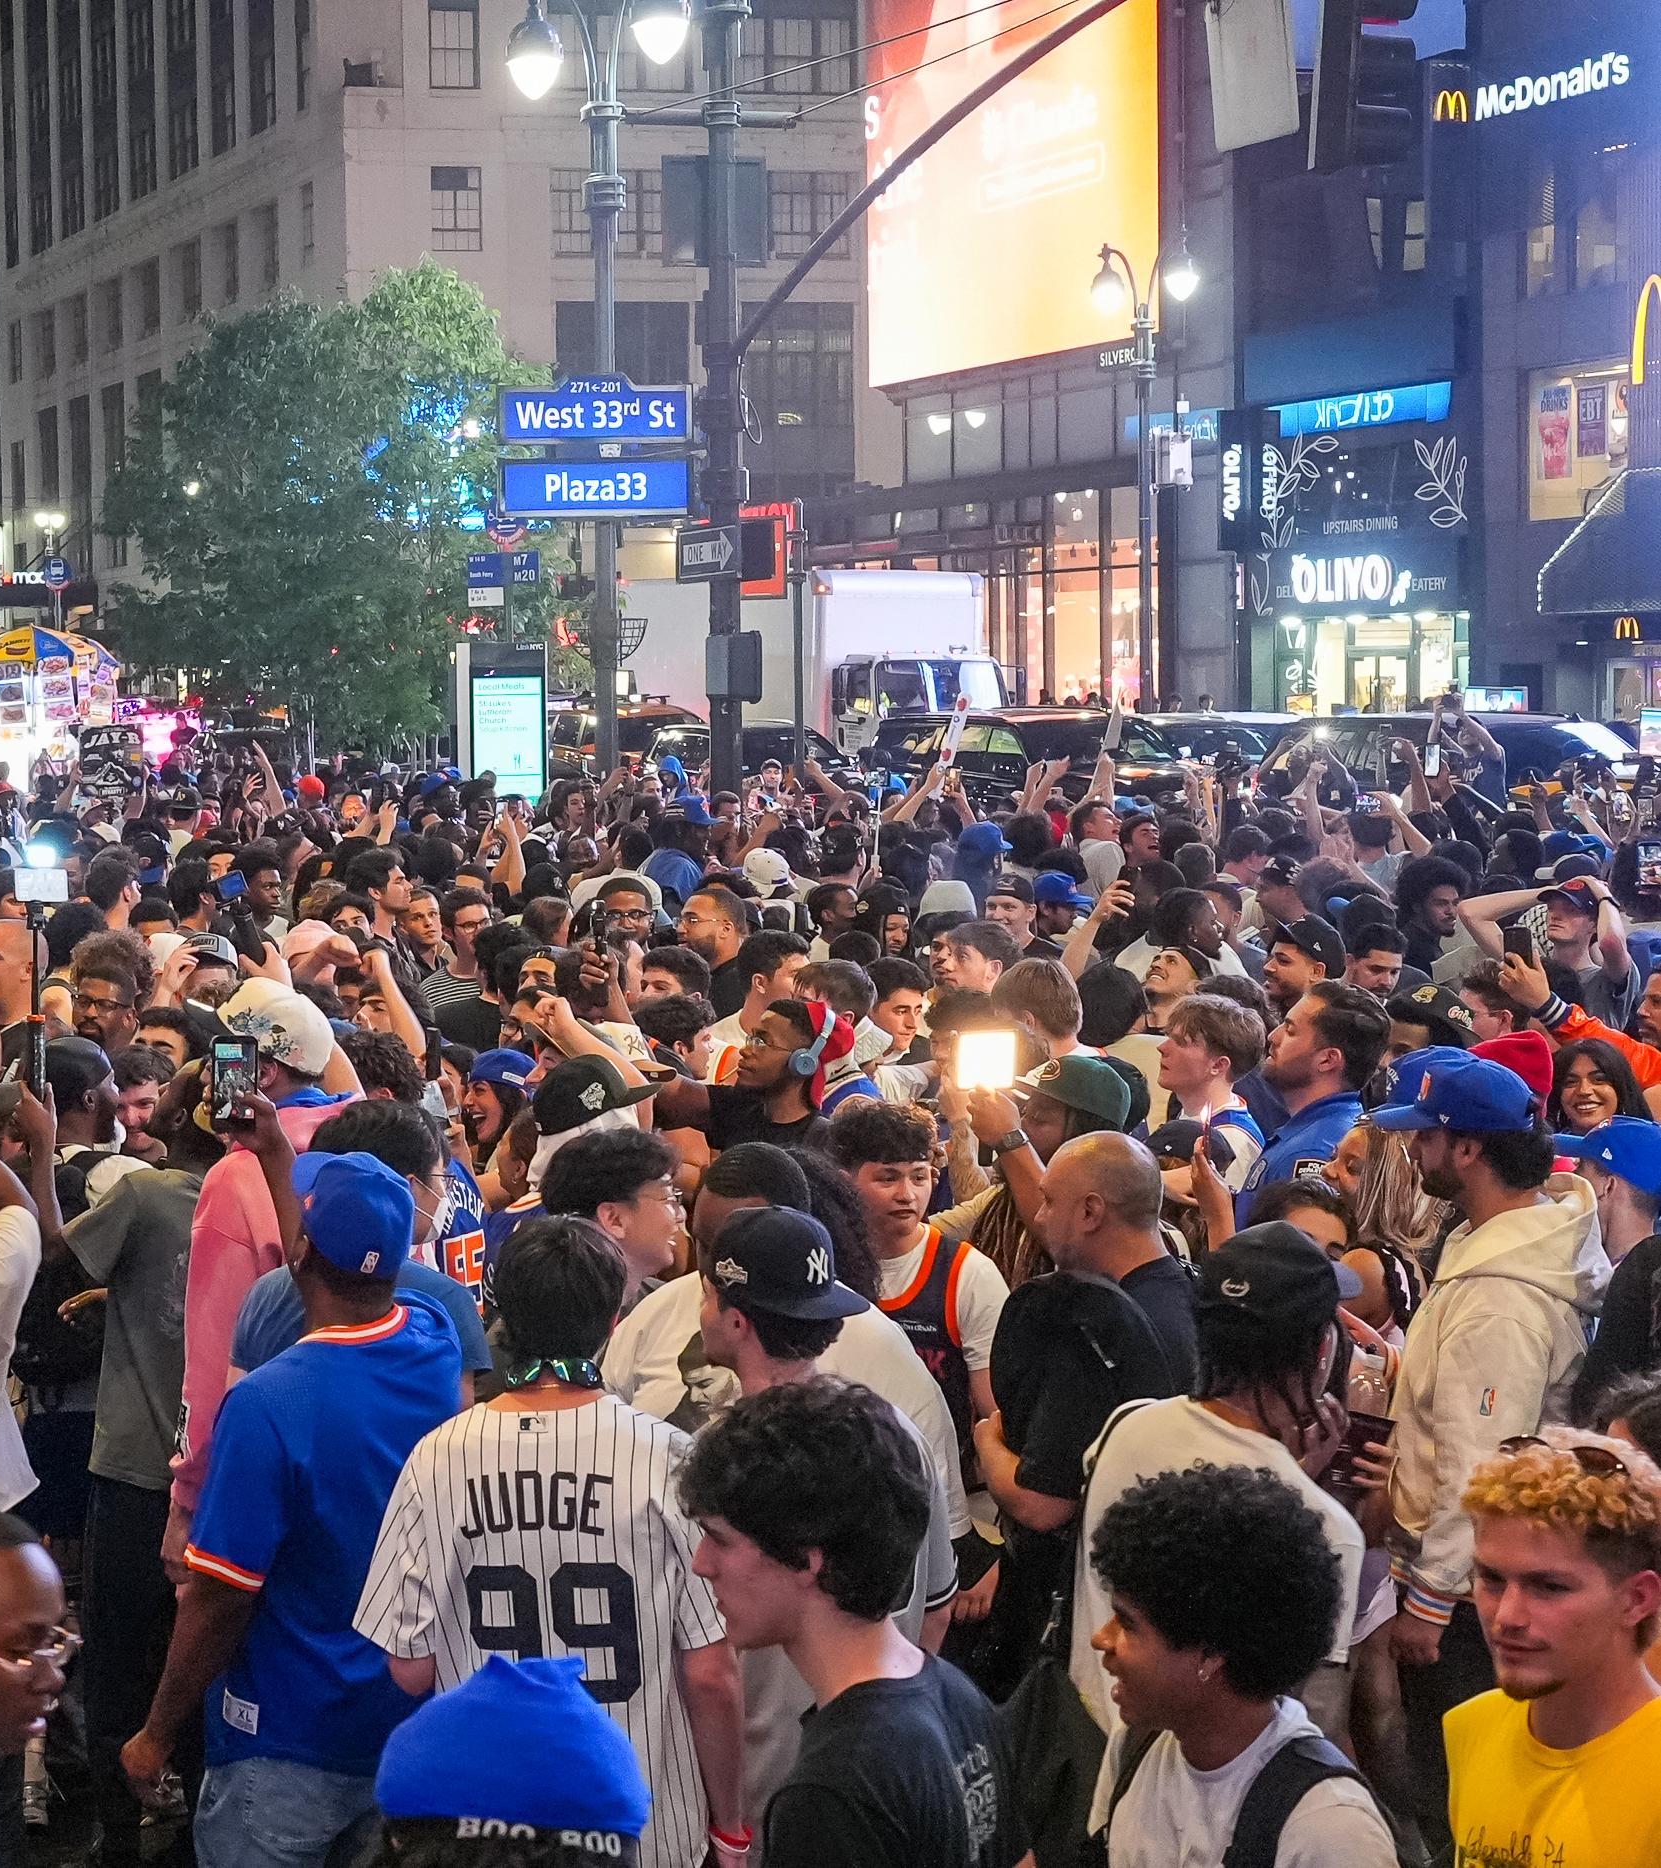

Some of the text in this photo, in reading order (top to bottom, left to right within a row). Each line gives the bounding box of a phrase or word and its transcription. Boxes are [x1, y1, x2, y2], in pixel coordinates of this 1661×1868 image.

[1475, 52, 1630, 121] McDonald's
[1099, 343, 1156, 367] SILVERCT
[570, 382, 621, 393] 271 201
[516, 398, 676, 429] West 33rd St
[1541, 397, 1568, 412] DRINKS
[1580, 397, 1602, 421] EBT
[545, 472, 647, 502] Plaza33
[1323, 516, 1398, 535] UPSTAIRS DINING
[513, 554, 527, 566] M7
[687, 541, 728, 563] ONE WAY
[514, 570, 536, 581] M20
[1291, 555, 1389, 603] OLIYO
[1412, 577, 1447, 592] EATERY
[443, 1229, 486, 1306] 55
[806, 1247, 828, 1285] NY
[460, 1470, 613, 1539] JUDGE
[465, 1562, 641, 1703] 99
[237, 1707, 252, 1722] XL
